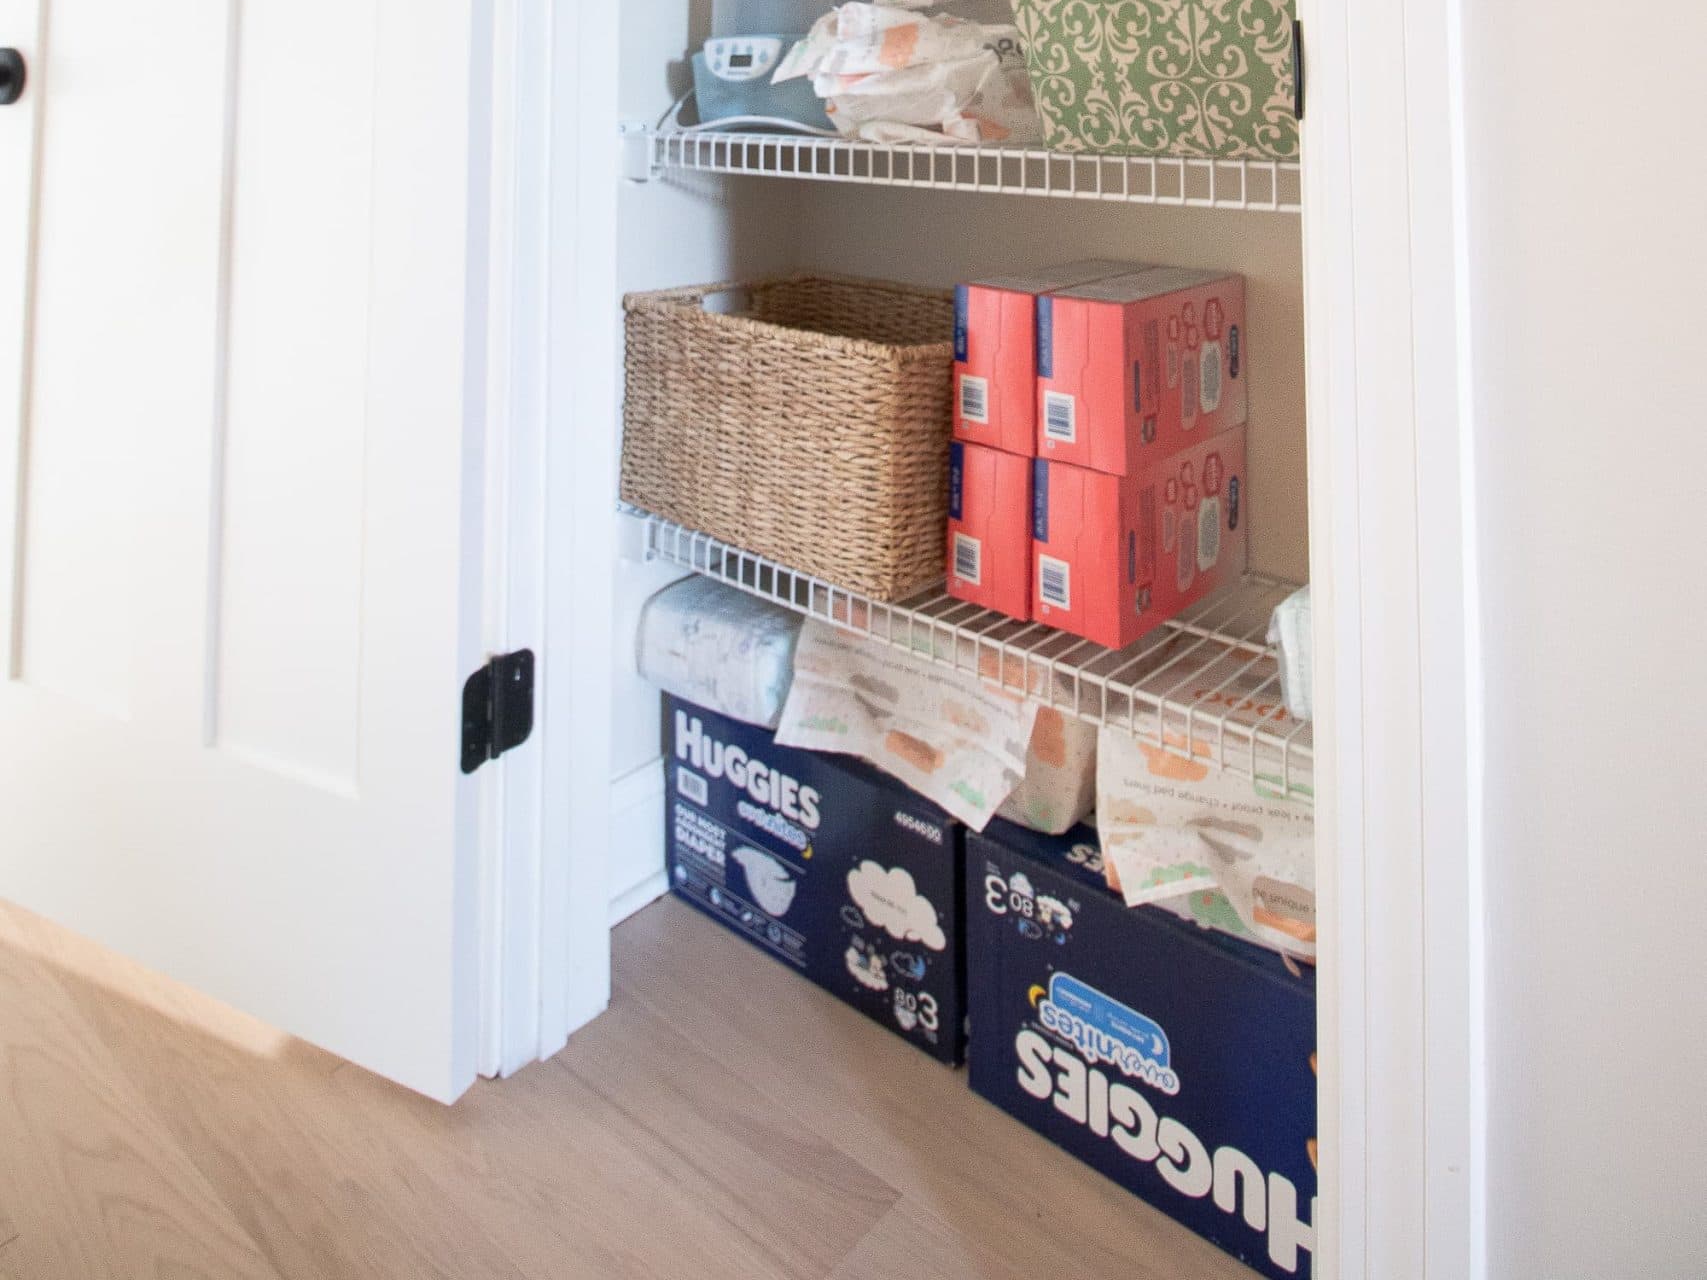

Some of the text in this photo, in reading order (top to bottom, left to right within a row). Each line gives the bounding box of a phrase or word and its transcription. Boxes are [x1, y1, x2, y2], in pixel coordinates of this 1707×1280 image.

[675, 709, 820, 829] HUGGIES
[984, 874, 1009, 915] 3
[1009, 891, 1034, 919] 80
[917, 991, 940, 1032] 3
[1040, 1000, 1179, 1094] overnites
[1014, 1029, 1317, 1280] HUGGIES
